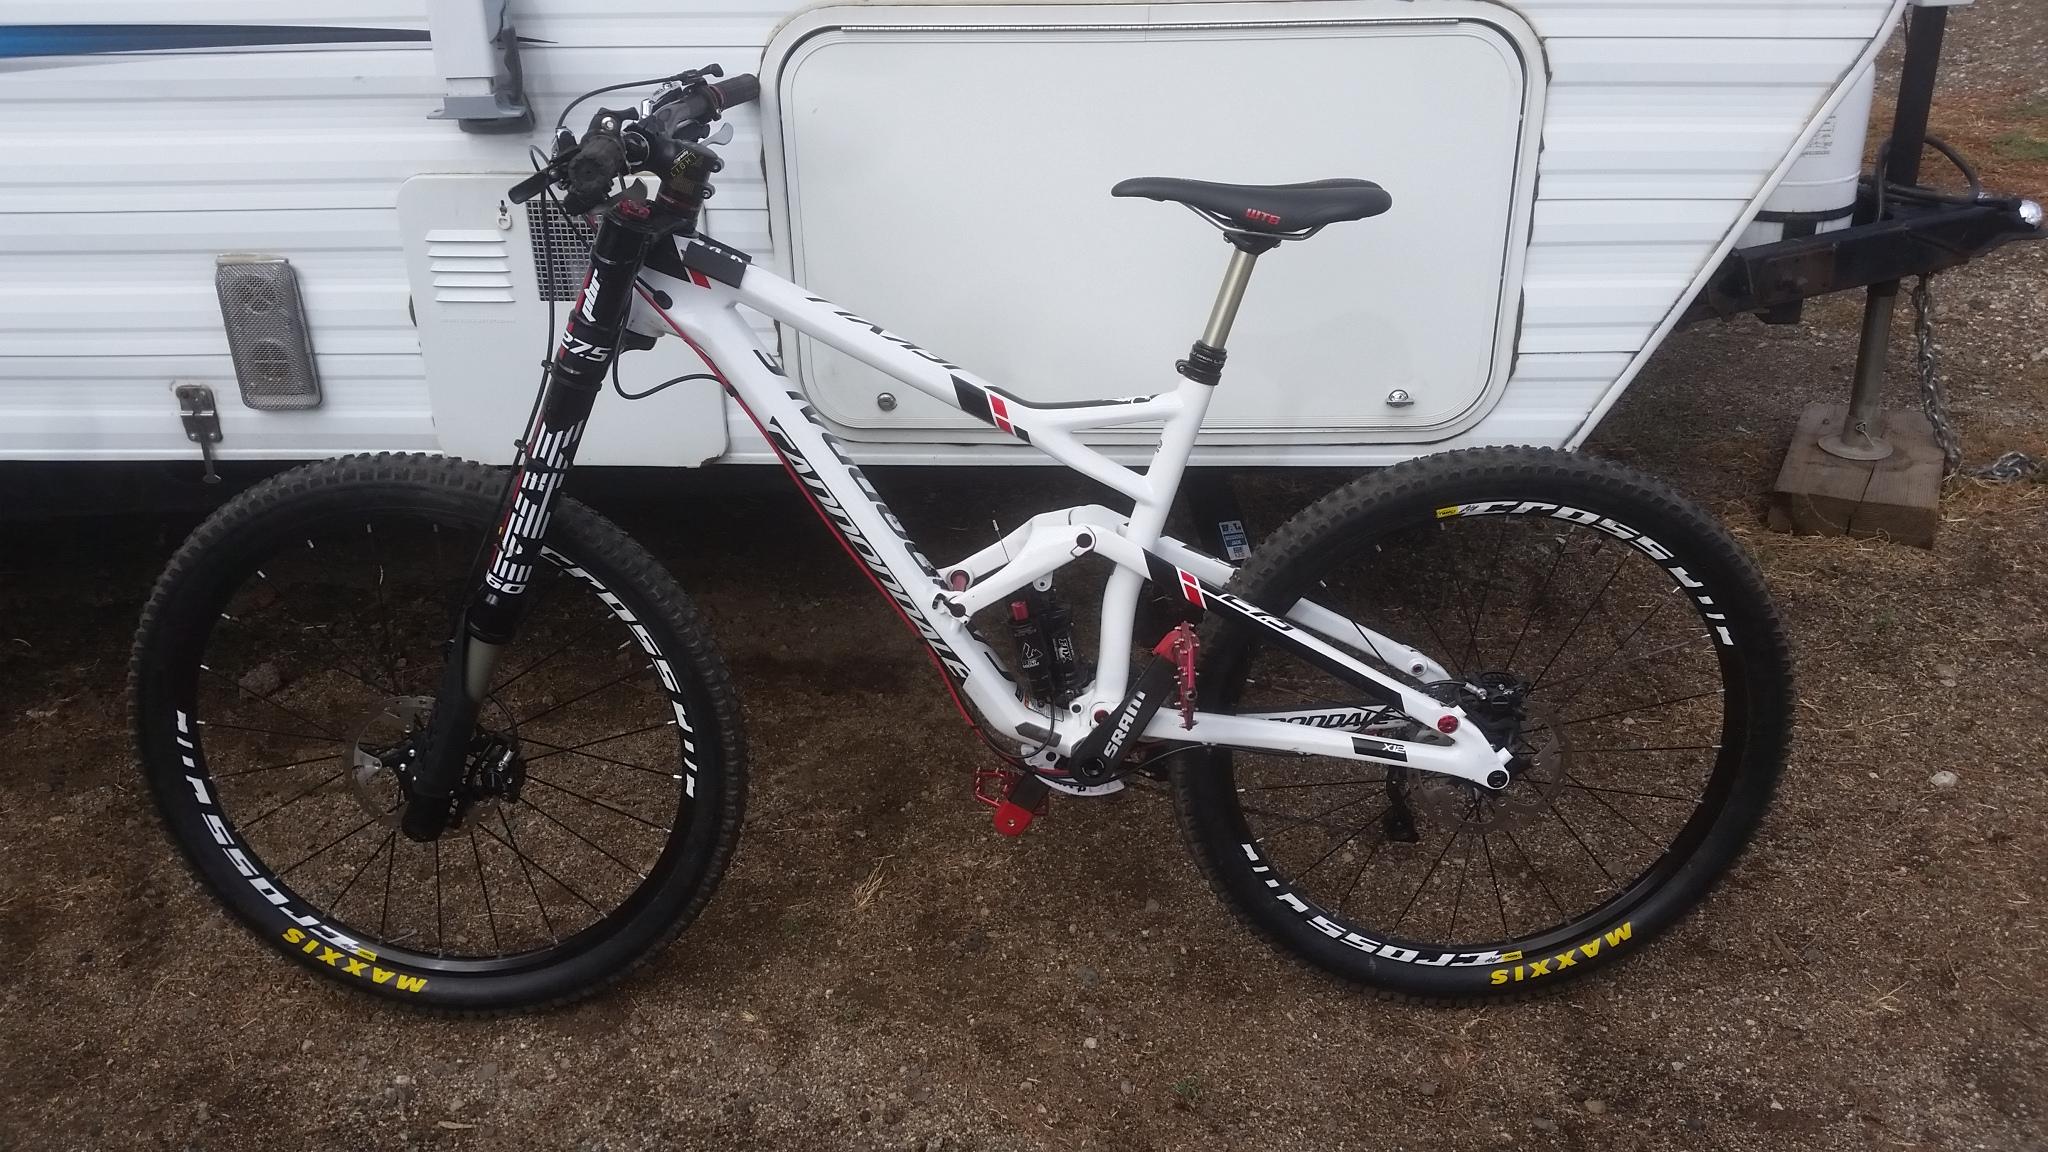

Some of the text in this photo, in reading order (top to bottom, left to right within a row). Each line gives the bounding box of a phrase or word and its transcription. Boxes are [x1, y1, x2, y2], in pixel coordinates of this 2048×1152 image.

[671, 153, 697, 177] LIGHT
[1246, 208, 1281, 225] WTB
[1103, 690, 1147, 759] SRAM
[281, 927, 428, 993] MAXXIS
[1490, 921, 1633, 986] MAXXIS
